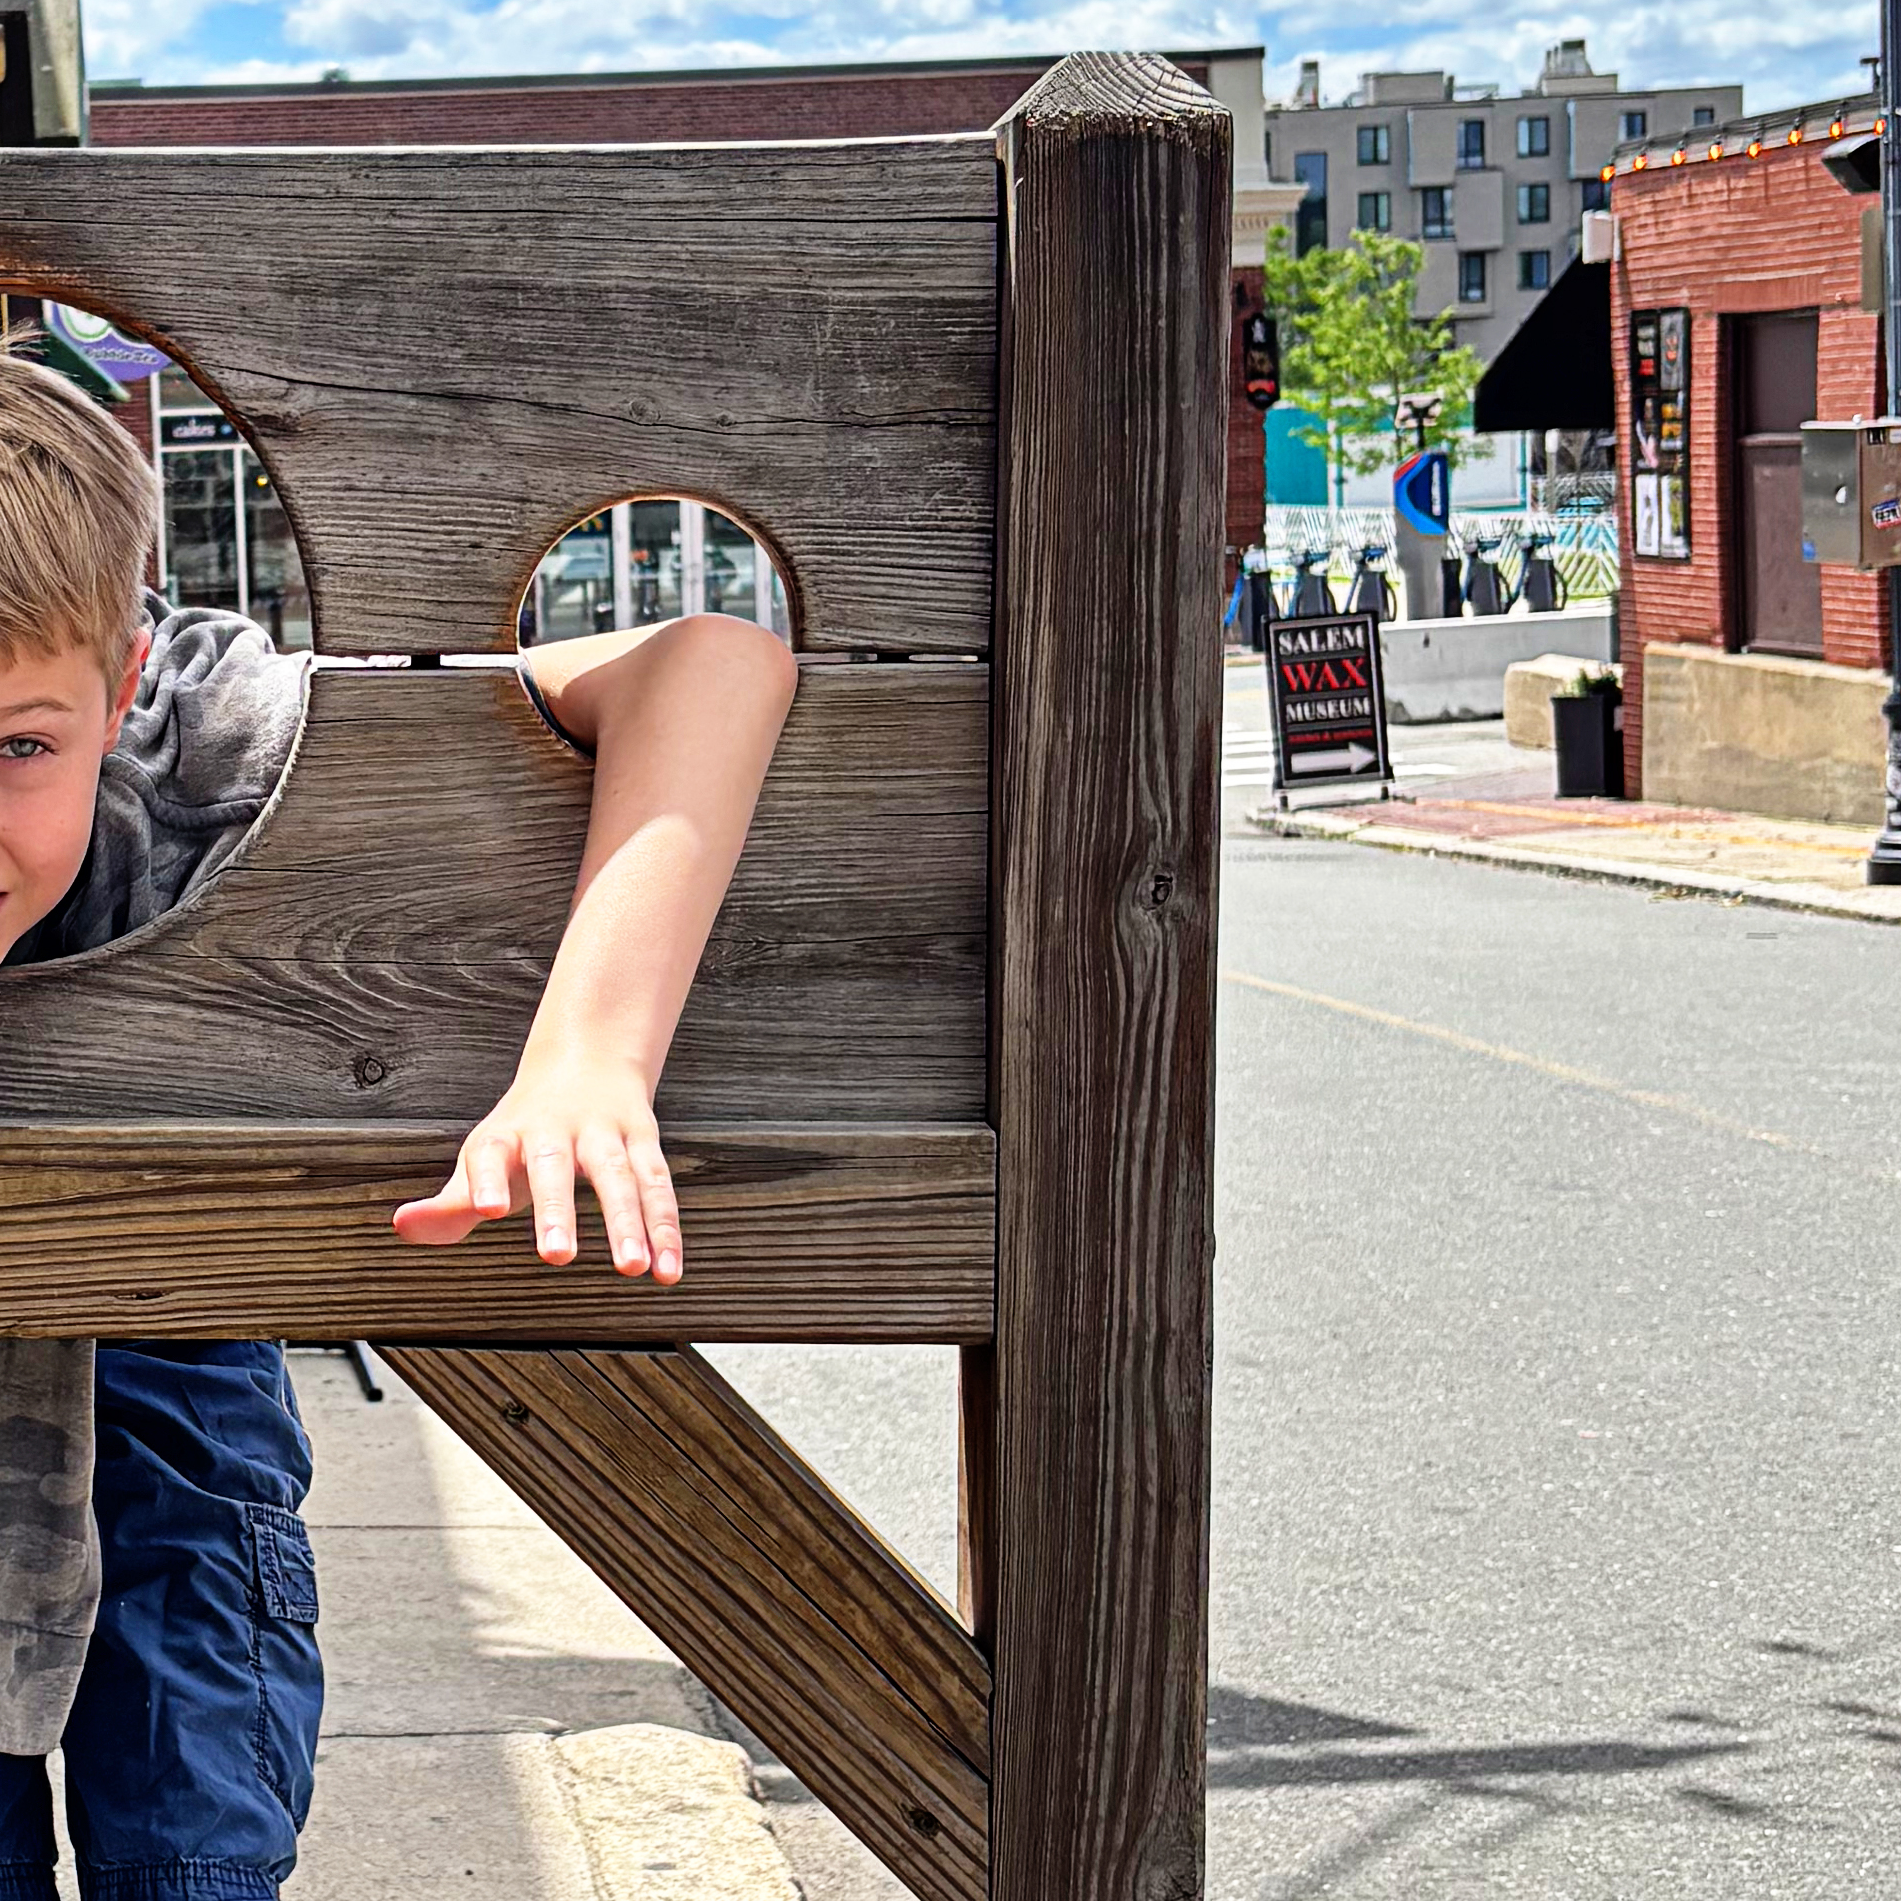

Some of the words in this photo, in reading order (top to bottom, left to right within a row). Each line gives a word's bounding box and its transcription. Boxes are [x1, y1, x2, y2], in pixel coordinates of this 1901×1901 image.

[1278, 625, 1365, 656] SALEM
[1281, 656, 1368, 692] WAX
[1285, 696, 1371, 724] MUSEUM
